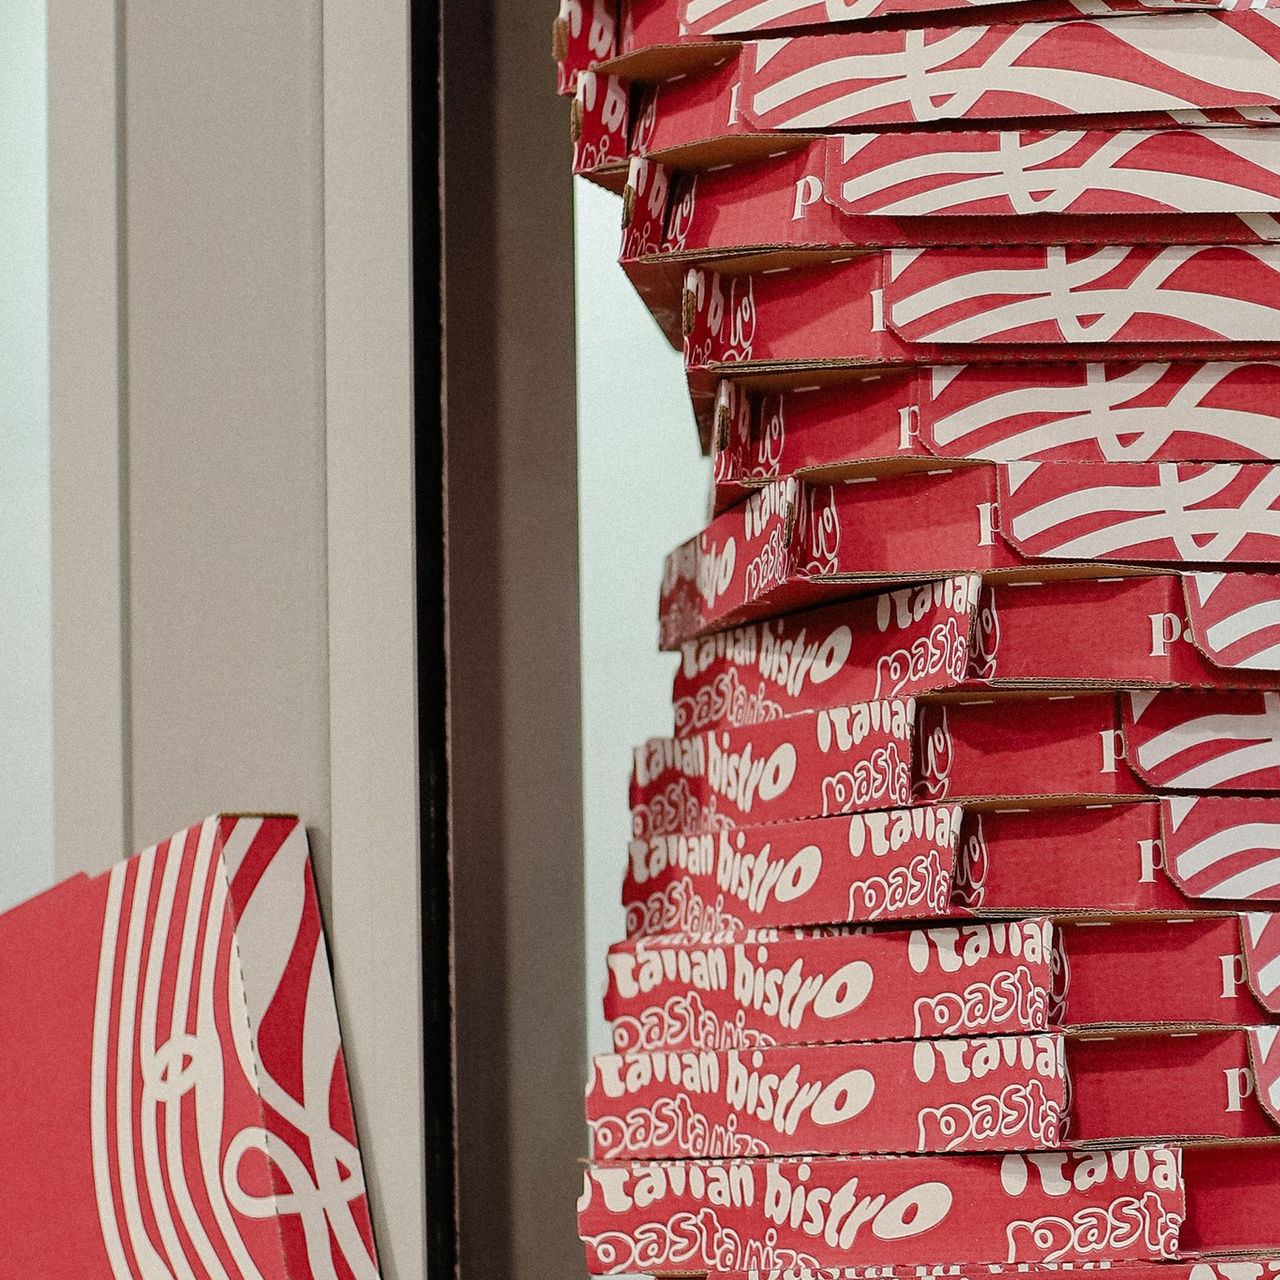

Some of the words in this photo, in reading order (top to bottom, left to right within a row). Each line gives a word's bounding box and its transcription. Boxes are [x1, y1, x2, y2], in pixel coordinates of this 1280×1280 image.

[707, 729, 797, 813] bistro
[717, 829, 822, 913] bistro
[734, 944, 874, 1030] bistro
[726, 1049, 875, 1136] bistro
[764, 1163, 952, 1250] bistro
